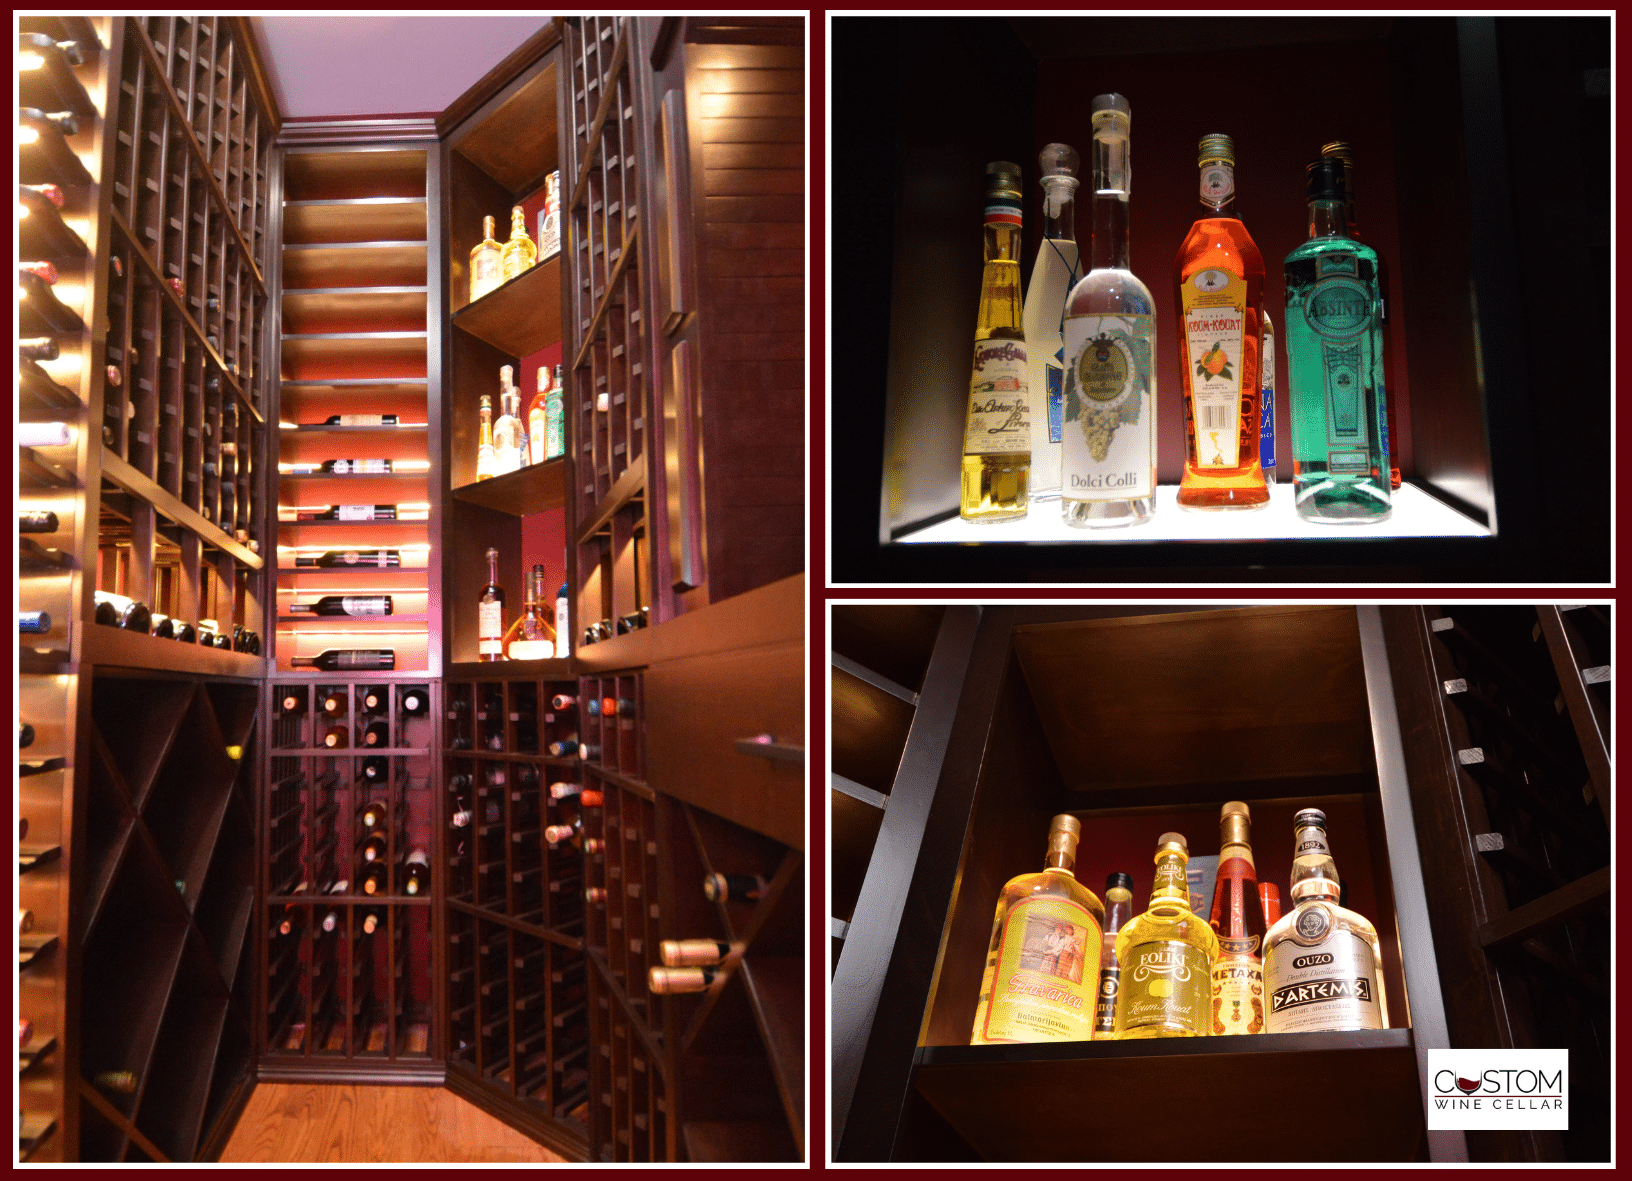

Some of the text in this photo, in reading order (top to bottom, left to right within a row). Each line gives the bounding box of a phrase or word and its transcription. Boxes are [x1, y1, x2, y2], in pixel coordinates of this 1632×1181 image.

[1070, 472, 1137, 488] Dolci Colli
[1301, 841, 1321, 851] 1892
[1140, 952, 1185, 967] EOLIKI
[1296, 954, 1332, 967] OUZO
[1008, 973, 1083, 1009] Travarica
